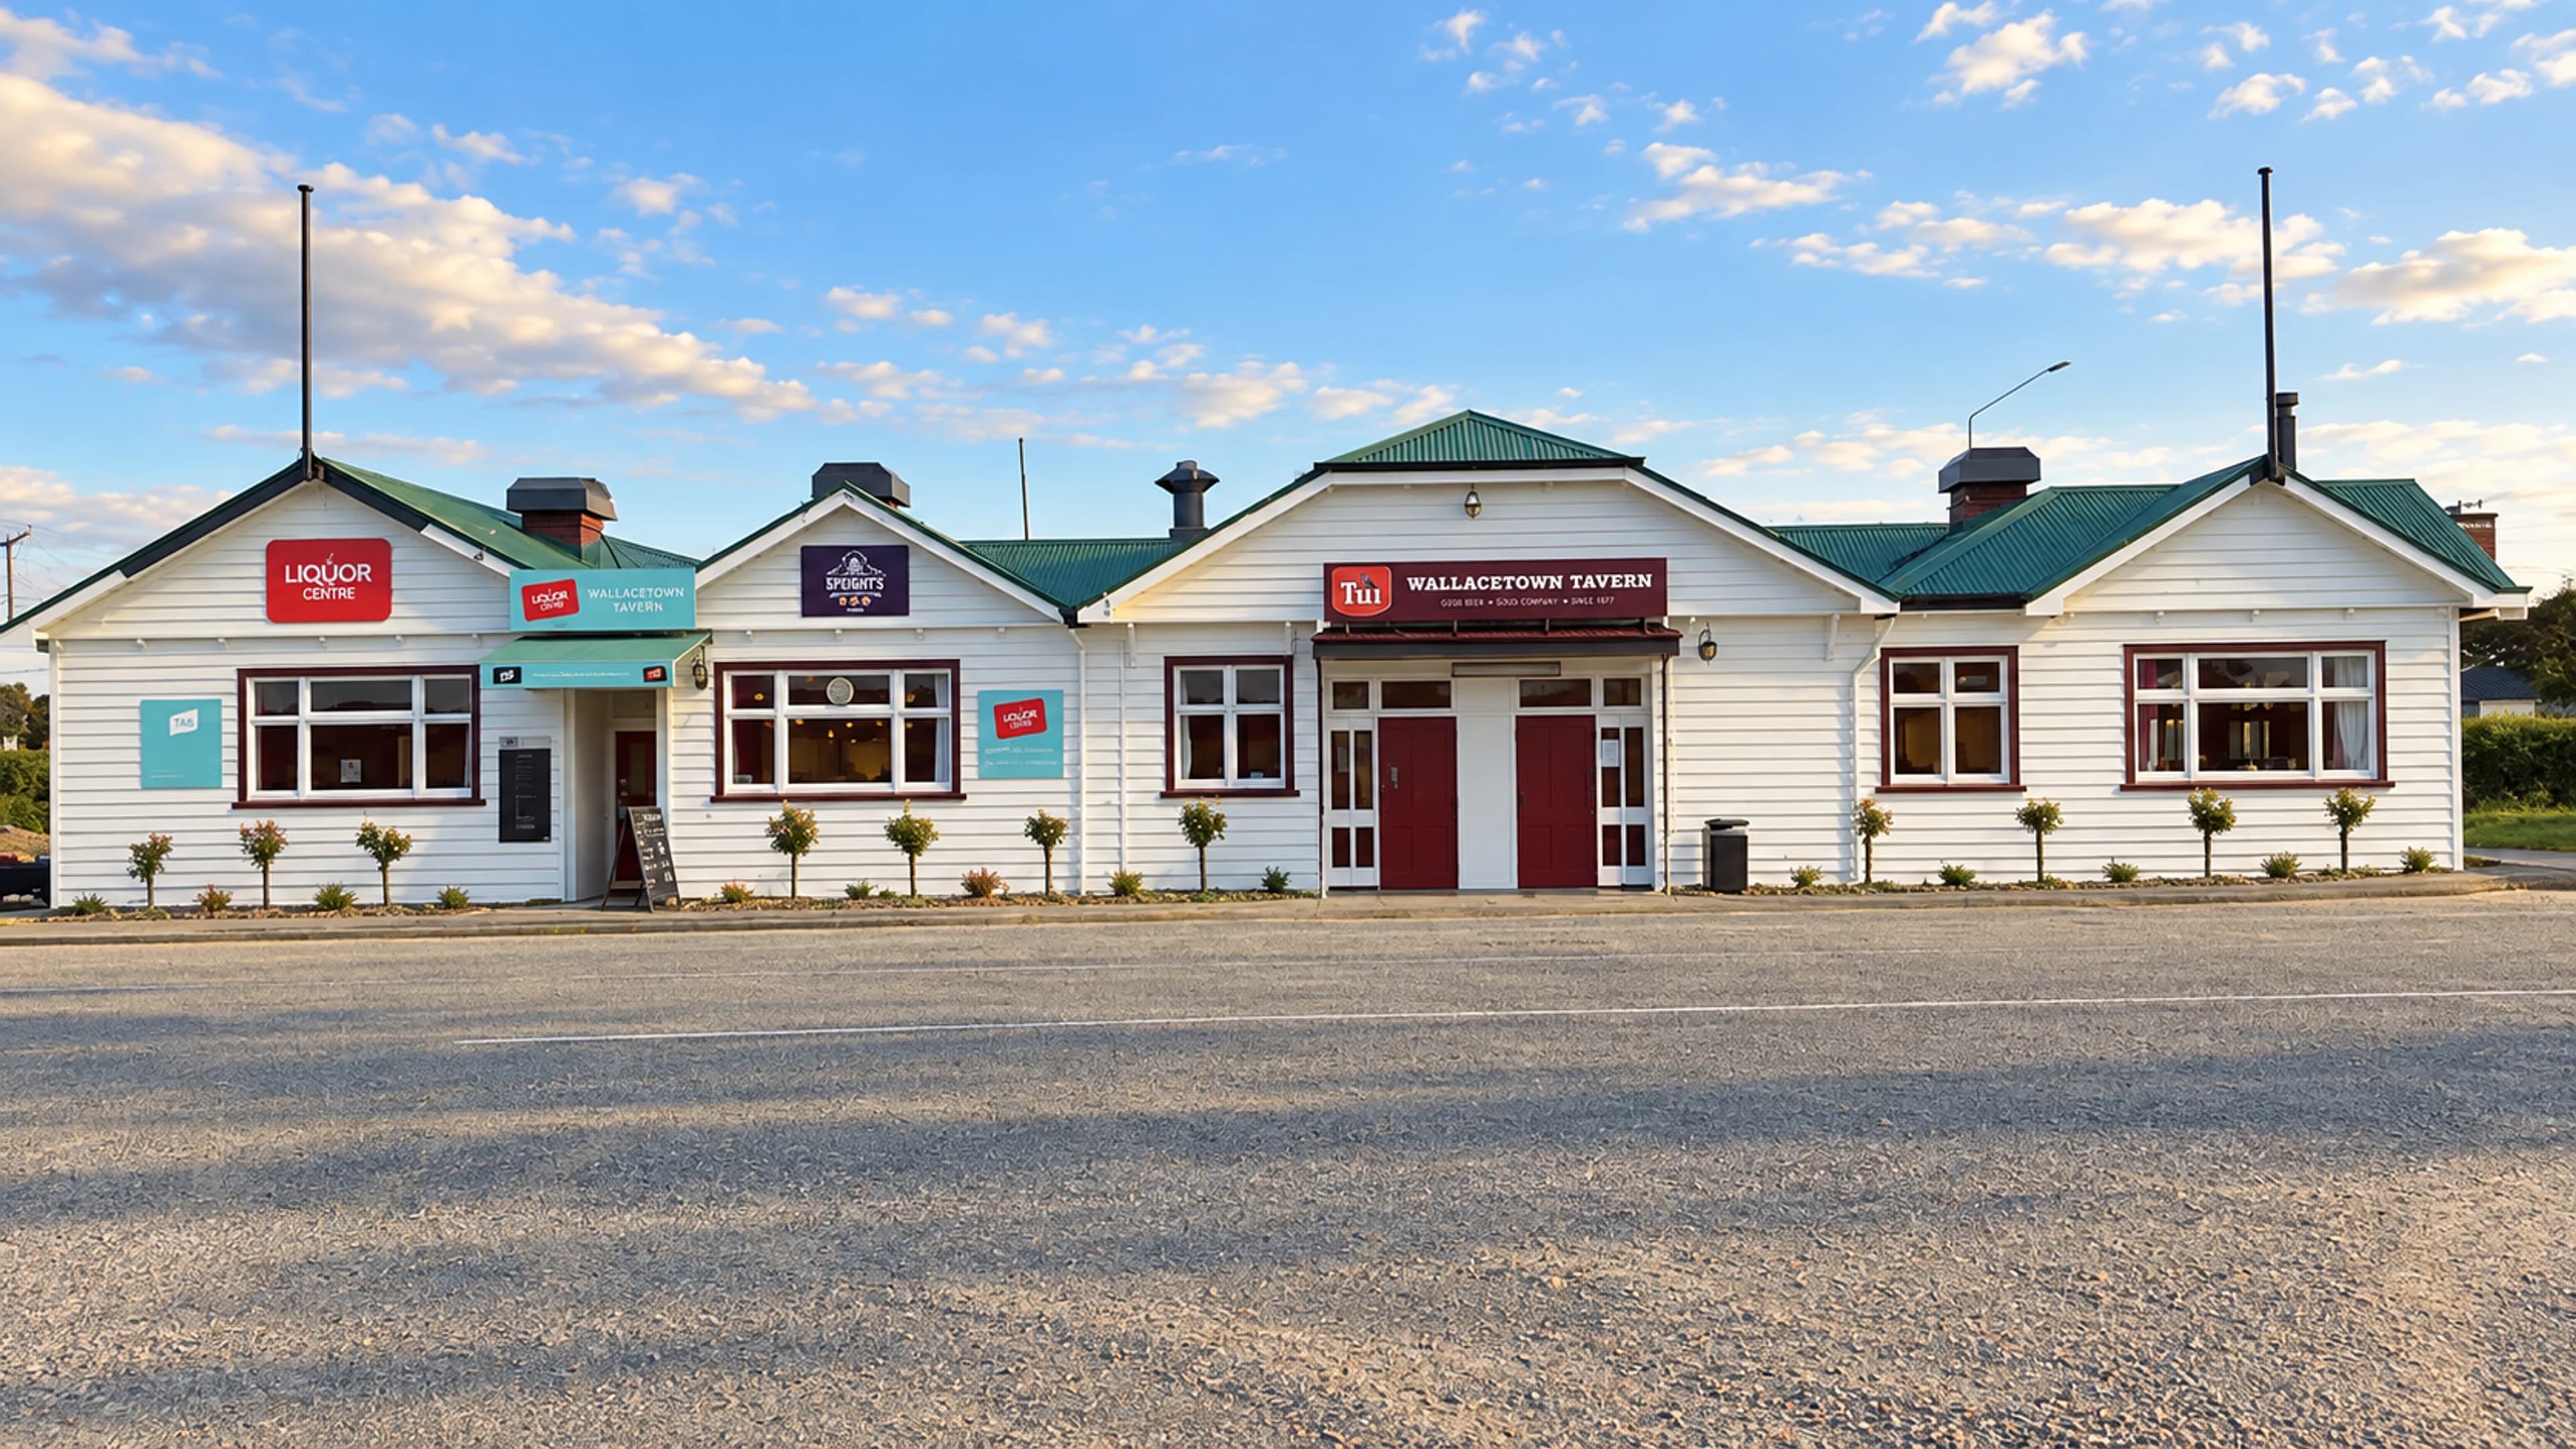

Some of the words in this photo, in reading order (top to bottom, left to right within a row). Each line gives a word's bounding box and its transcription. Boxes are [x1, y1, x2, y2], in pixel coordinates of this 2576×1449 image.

[285, 564, 372, 586] LIQUOR
[1406, 576, 1563, 590] WALLACETOWN
[1570, 574, 1652, 589] TAVERN
[303, 587, 355, 600] CENTRE
[588, 588, 684, 599] WALLACETOWN
[1340, 582, 1382, 605] Tui
[613, 601, 663, 612] TAVERN
[173, 718, 194, 728] TAB
